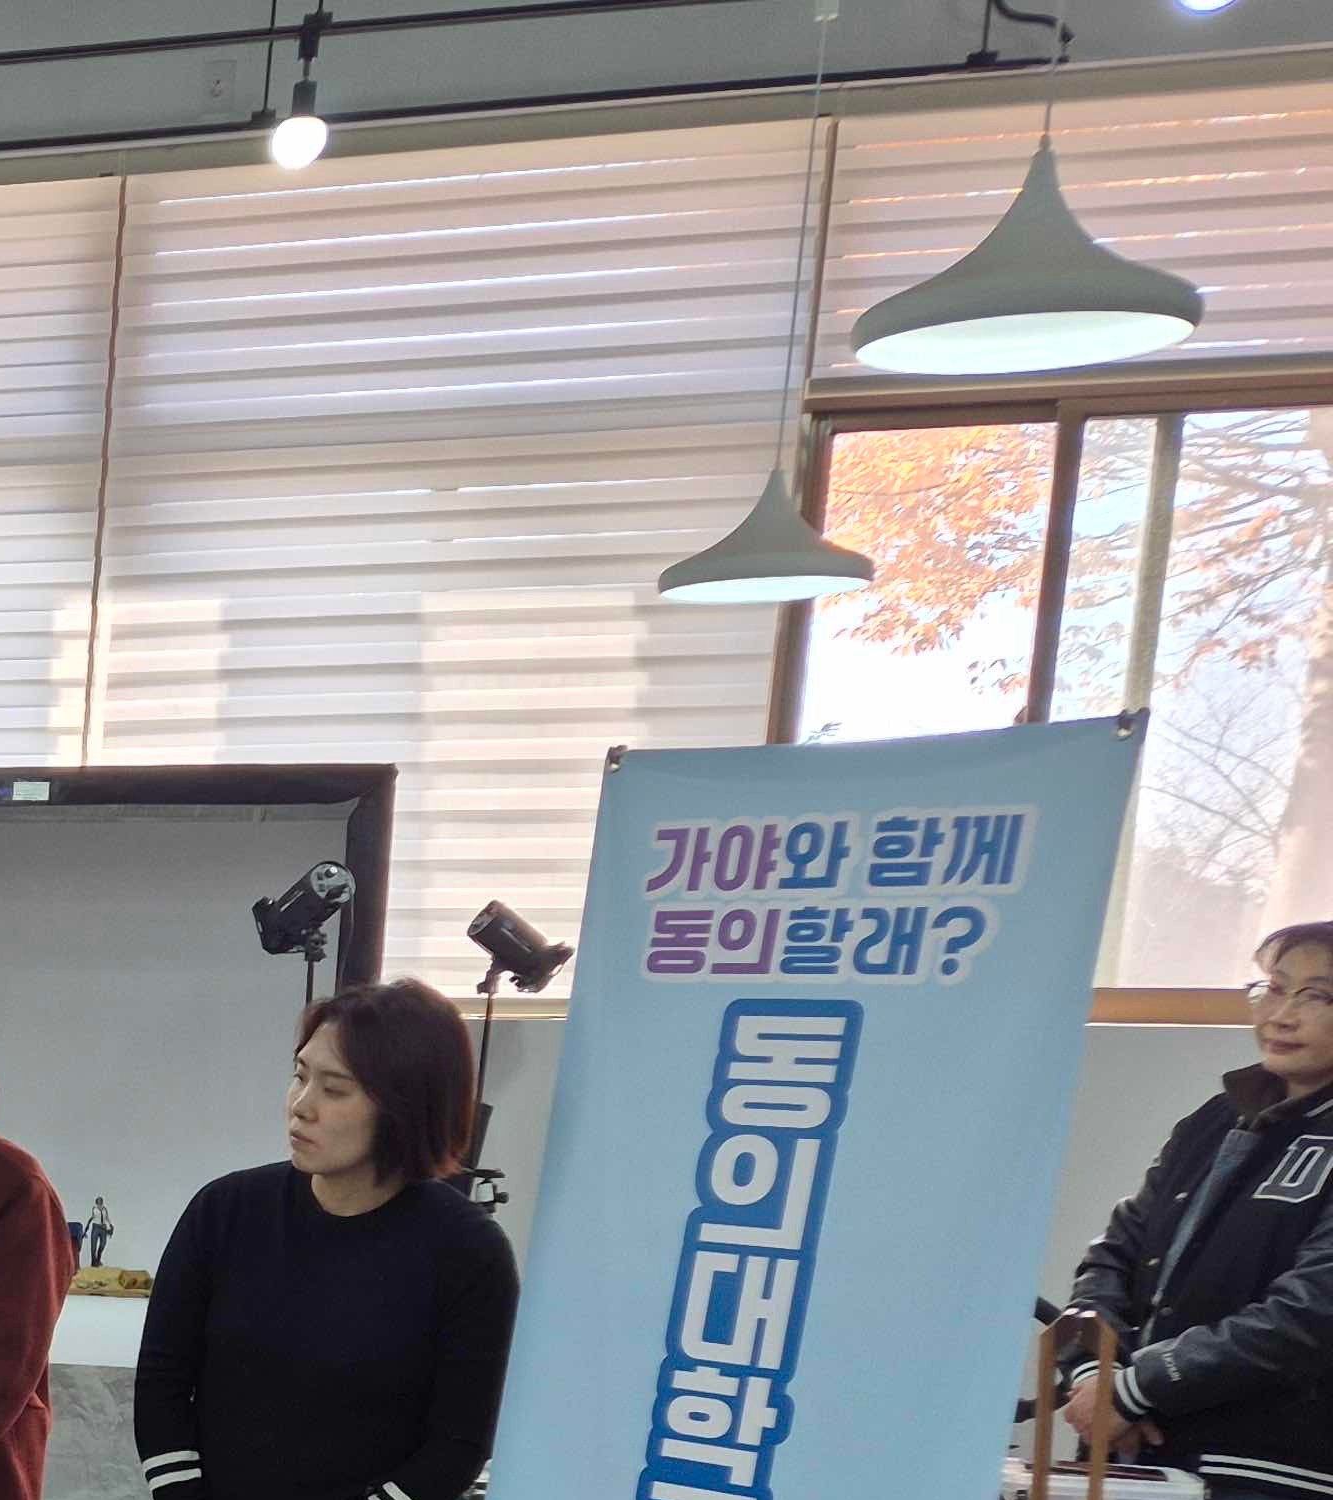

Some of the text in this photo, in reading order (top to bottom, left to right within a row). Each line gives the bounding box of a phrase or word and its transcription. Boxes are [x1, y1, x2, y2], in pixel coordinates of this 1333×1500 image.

[645, 813, 1027, 894] 가야와 함께
[646, 904, 988, 978] 동의할래?
[1252, 1134, 1333, 1203] D
